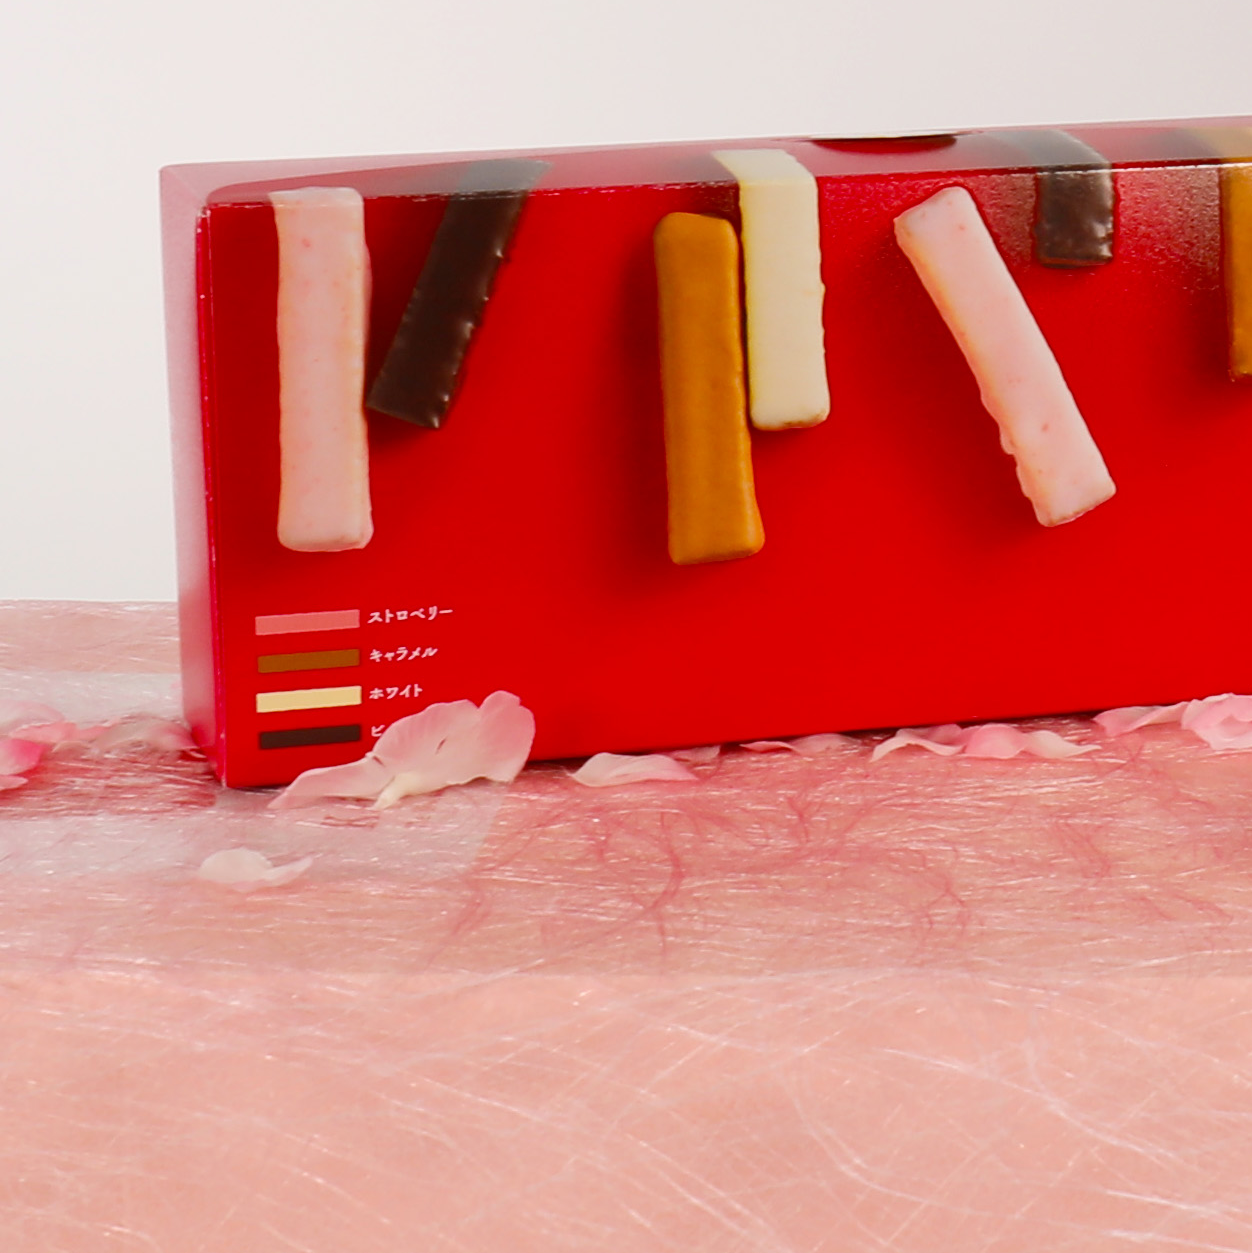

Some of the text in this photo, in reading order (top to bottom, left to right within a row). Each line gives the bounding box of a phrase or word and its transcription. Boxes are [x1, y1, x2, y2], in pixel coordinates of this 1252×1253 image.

[367, 605, 453, 624] ストロベリー
[369, 646, 438, 662] キャラメル
[369, 683, 423, 700] ホワイト
